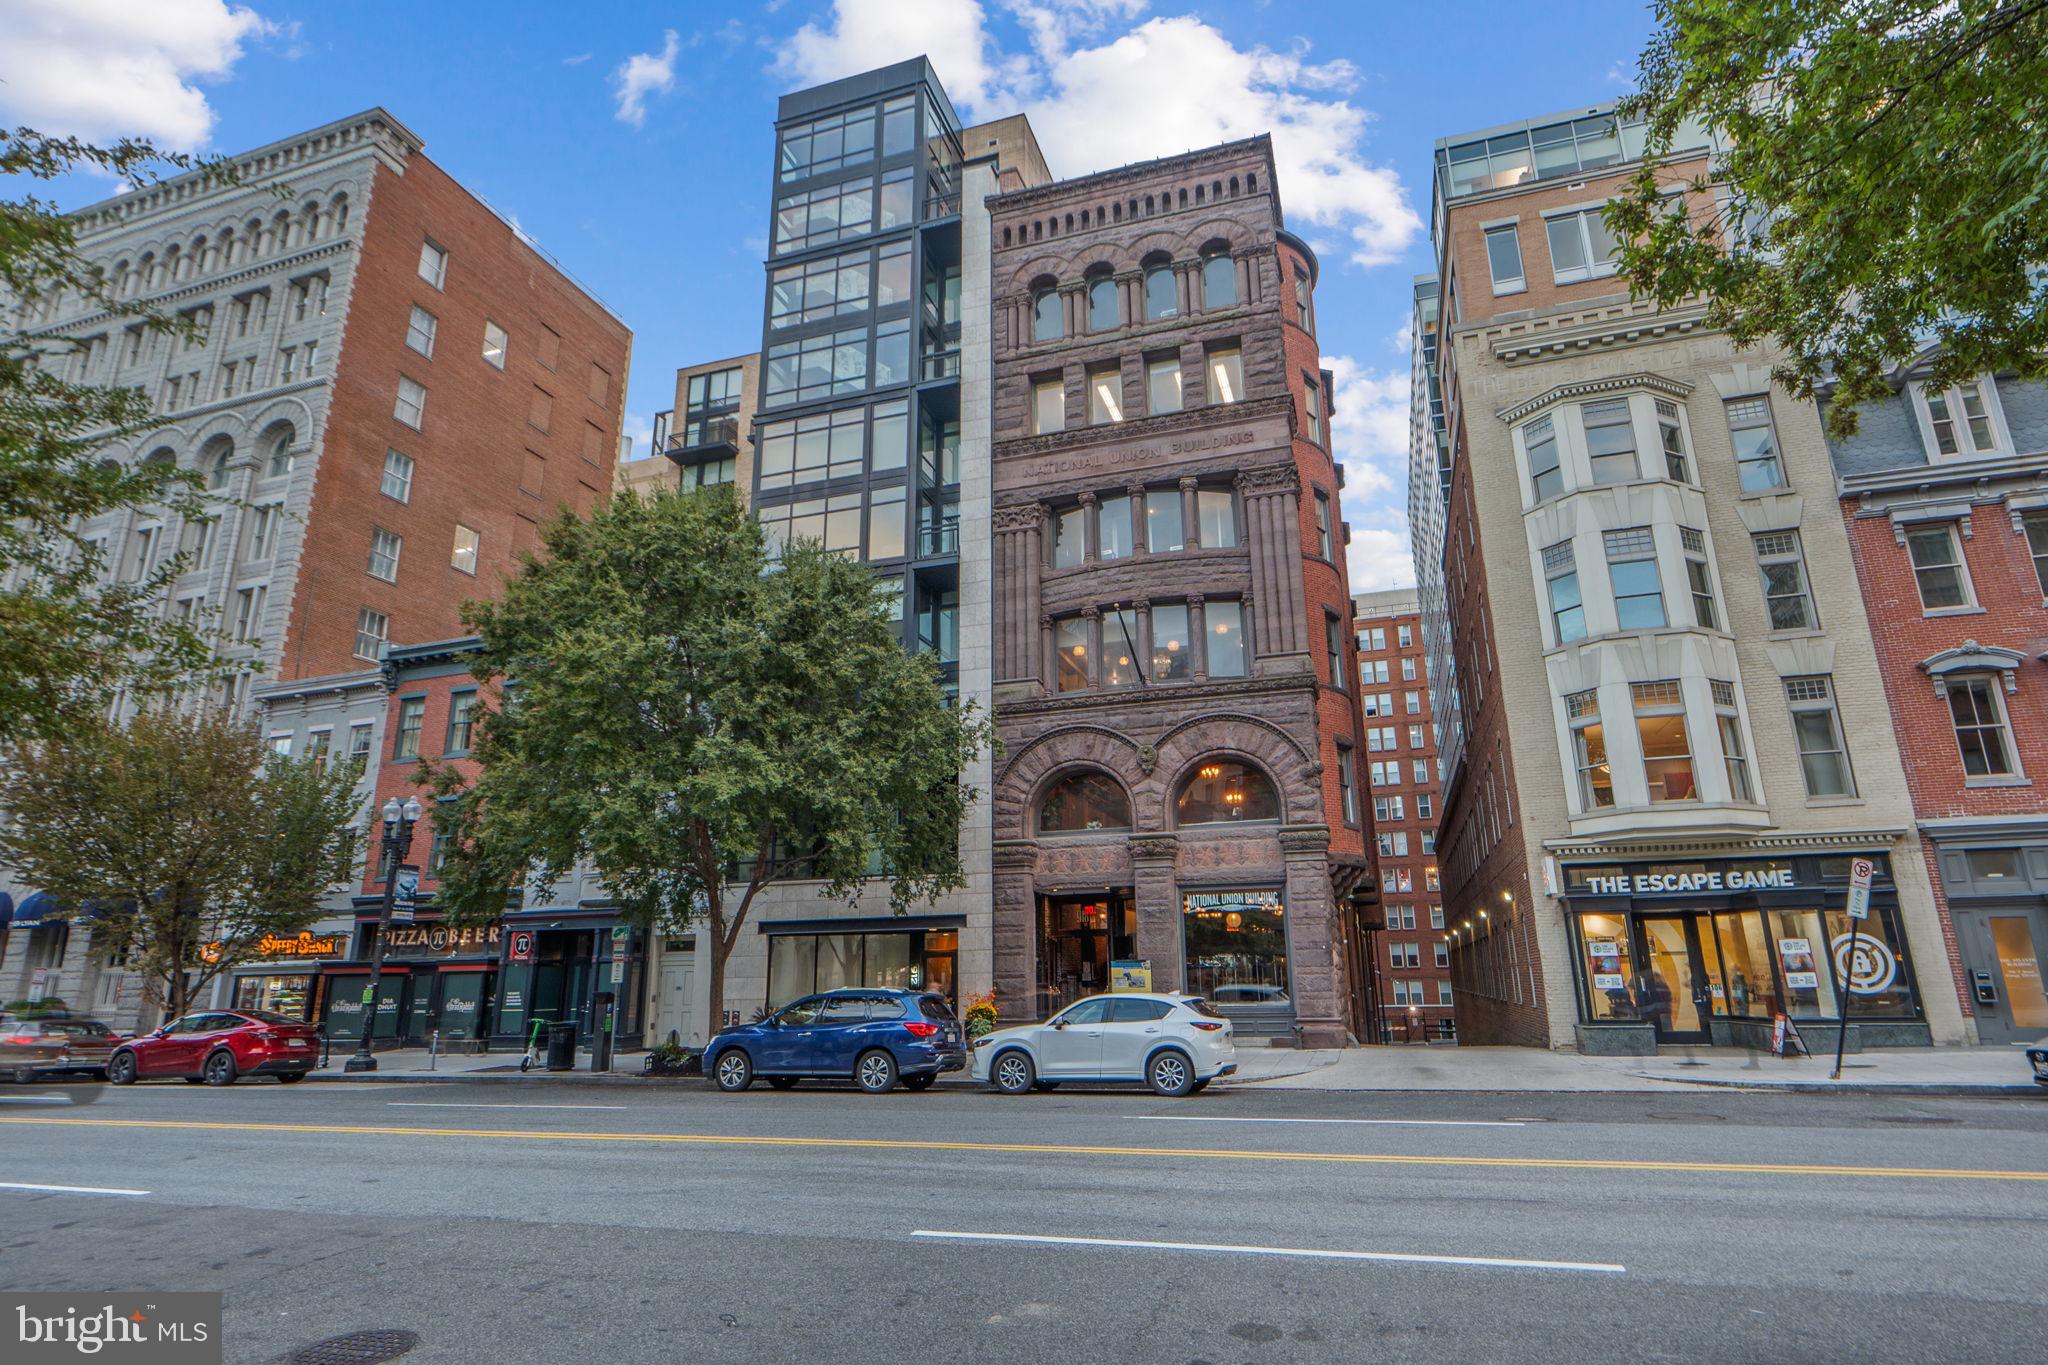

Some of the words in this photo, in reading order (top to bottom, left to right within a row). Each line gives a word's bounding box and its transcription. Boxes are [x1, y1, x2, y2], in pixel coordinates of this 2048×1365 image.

[1022, 457, 1101, 479] NATIONAL
[1109, 446, 1162, 464] UNION
[1170, 430, 1254, 456] BUILDING
[1585, 875, 1632, 894] THE
[1633, 871, 1724, 893] ESCAPE
[1726, 869, 1795, 890] GAME
[1186, 893, 1220, 909] NATIONAL
[1221, 892, 1244, 905] UNION
[1245, 891, 1279, 906] BUILDING
[448, 926, 500, 944] BEER
[910, 965, 919, 985] 912
